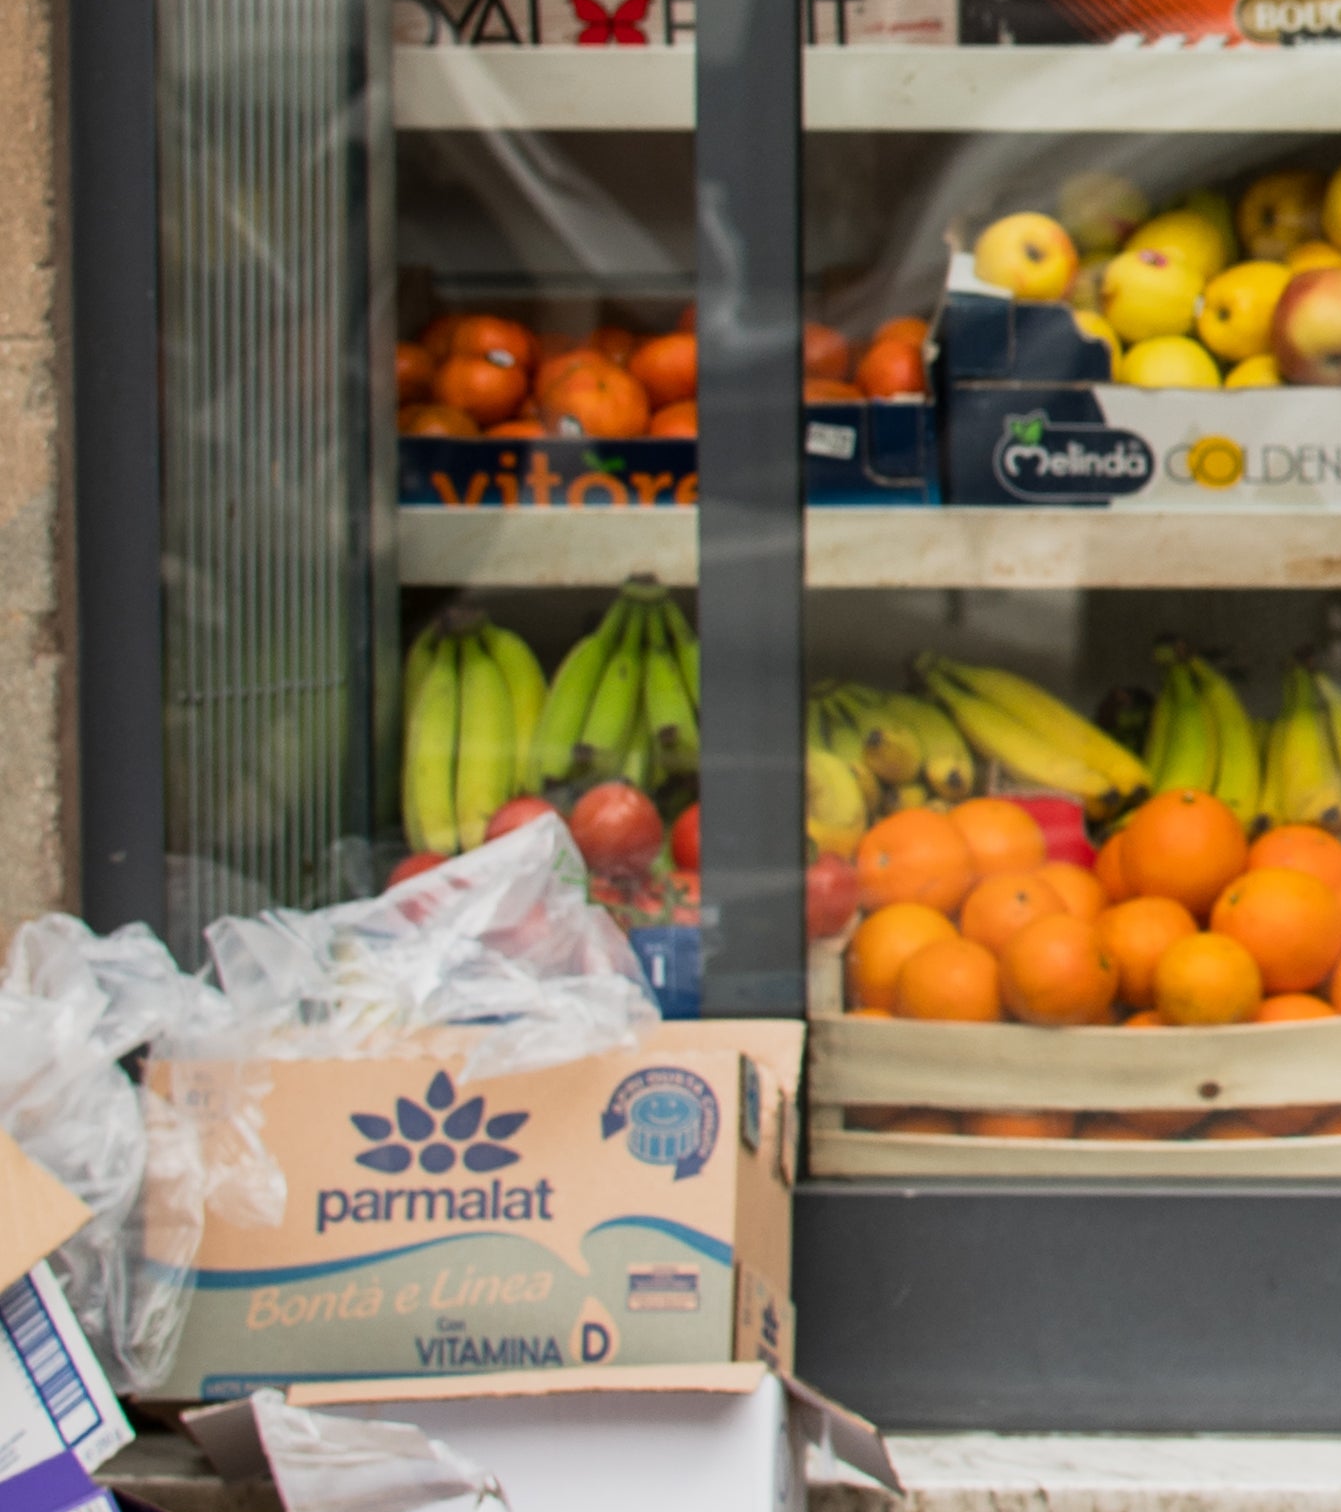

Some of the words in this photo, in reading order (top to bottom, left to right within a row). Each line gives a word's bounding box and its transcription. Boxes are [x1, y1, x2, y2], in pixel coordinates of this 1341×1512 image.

[316, 1177, 556, 1233] parmalat
[247, 1273, 382, 1332] Bontà
[396, 1281, 420, 1312] e
[430, 1266, 552, 1314] Linea
[414, 1335, 564, 1369] VITAMINA
[580, 1323, 612, 1364] D
